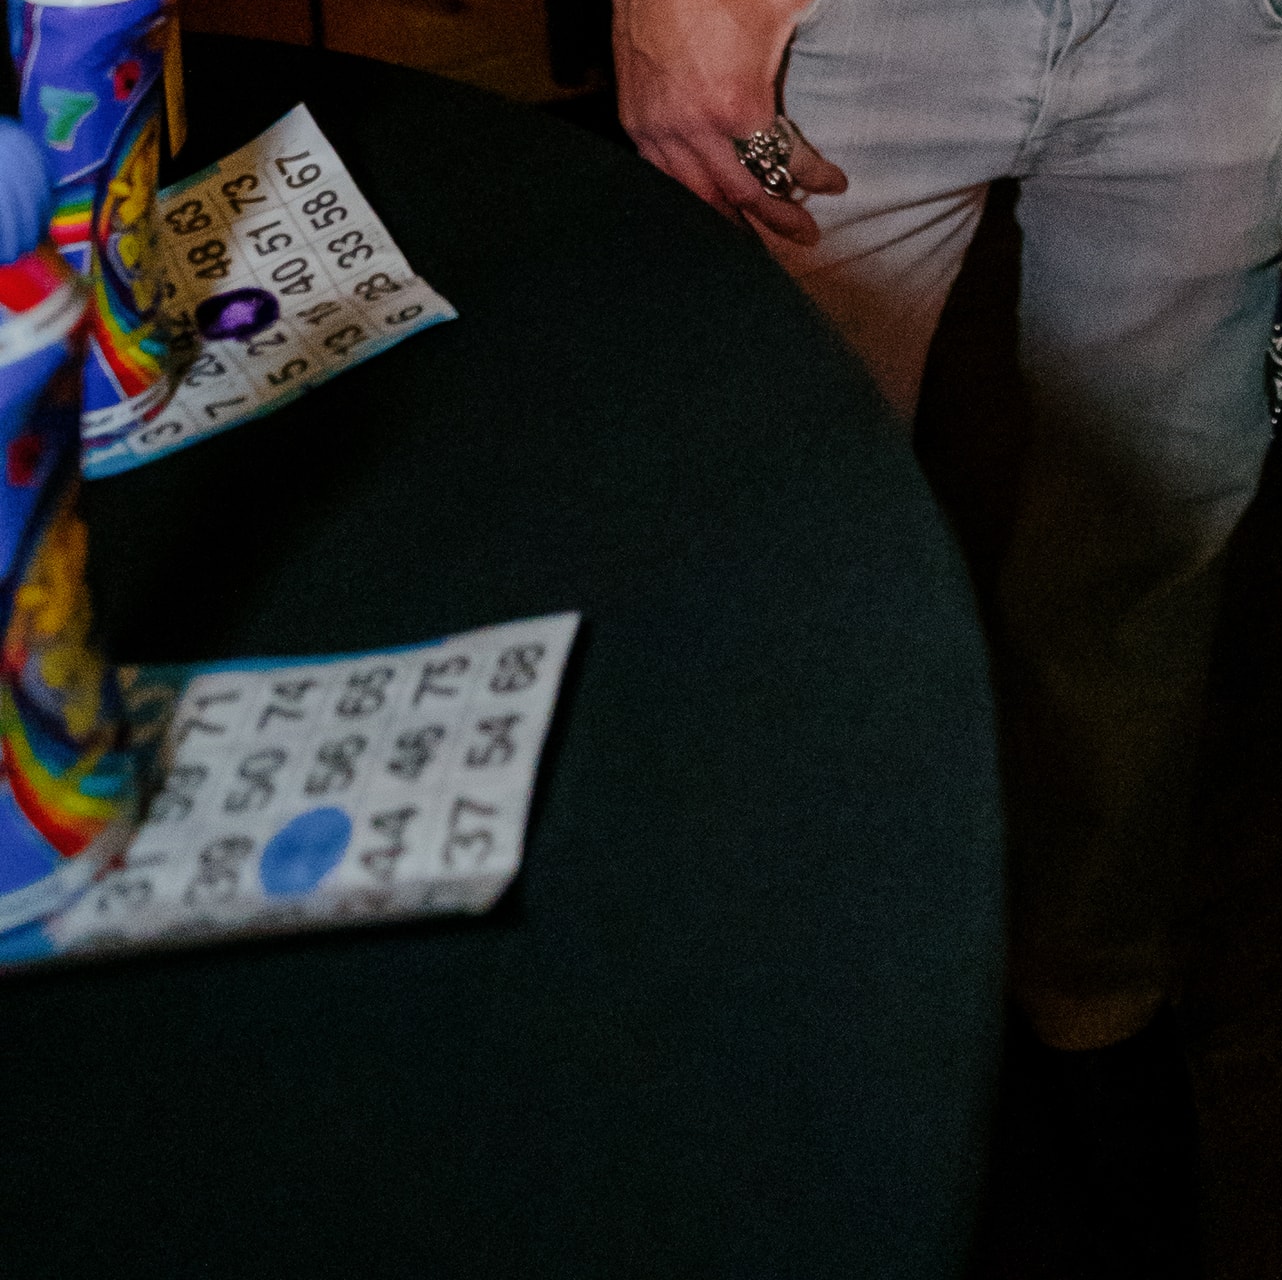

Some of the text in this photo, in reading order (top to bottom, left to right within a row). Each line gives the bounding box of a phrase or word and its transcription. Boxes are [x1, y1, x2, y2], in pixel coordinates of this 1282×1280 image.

[273, 151, 322, 189] 67
[220, 172, 266, 215] 73
[302, 190, 348, 231] 58
[164, 199, 213, 236] 63
[245, 220, 293, 256] 51
[327, 230, 374, 269] 33
[186, 238, 231, 280] 48
[271, 257, 315, 296] 40
[384, 304, 423, 326] 6
[322, 324, 366, 356] 13
[267, 358, 309, 386] 5
[204, 395, 248, 420] 7
[169, 691, 239, 746] 71
[224, 748, 288, 813] 50
[258, 678, 317, 729] 74
[442, 796, 498, 865] 37
